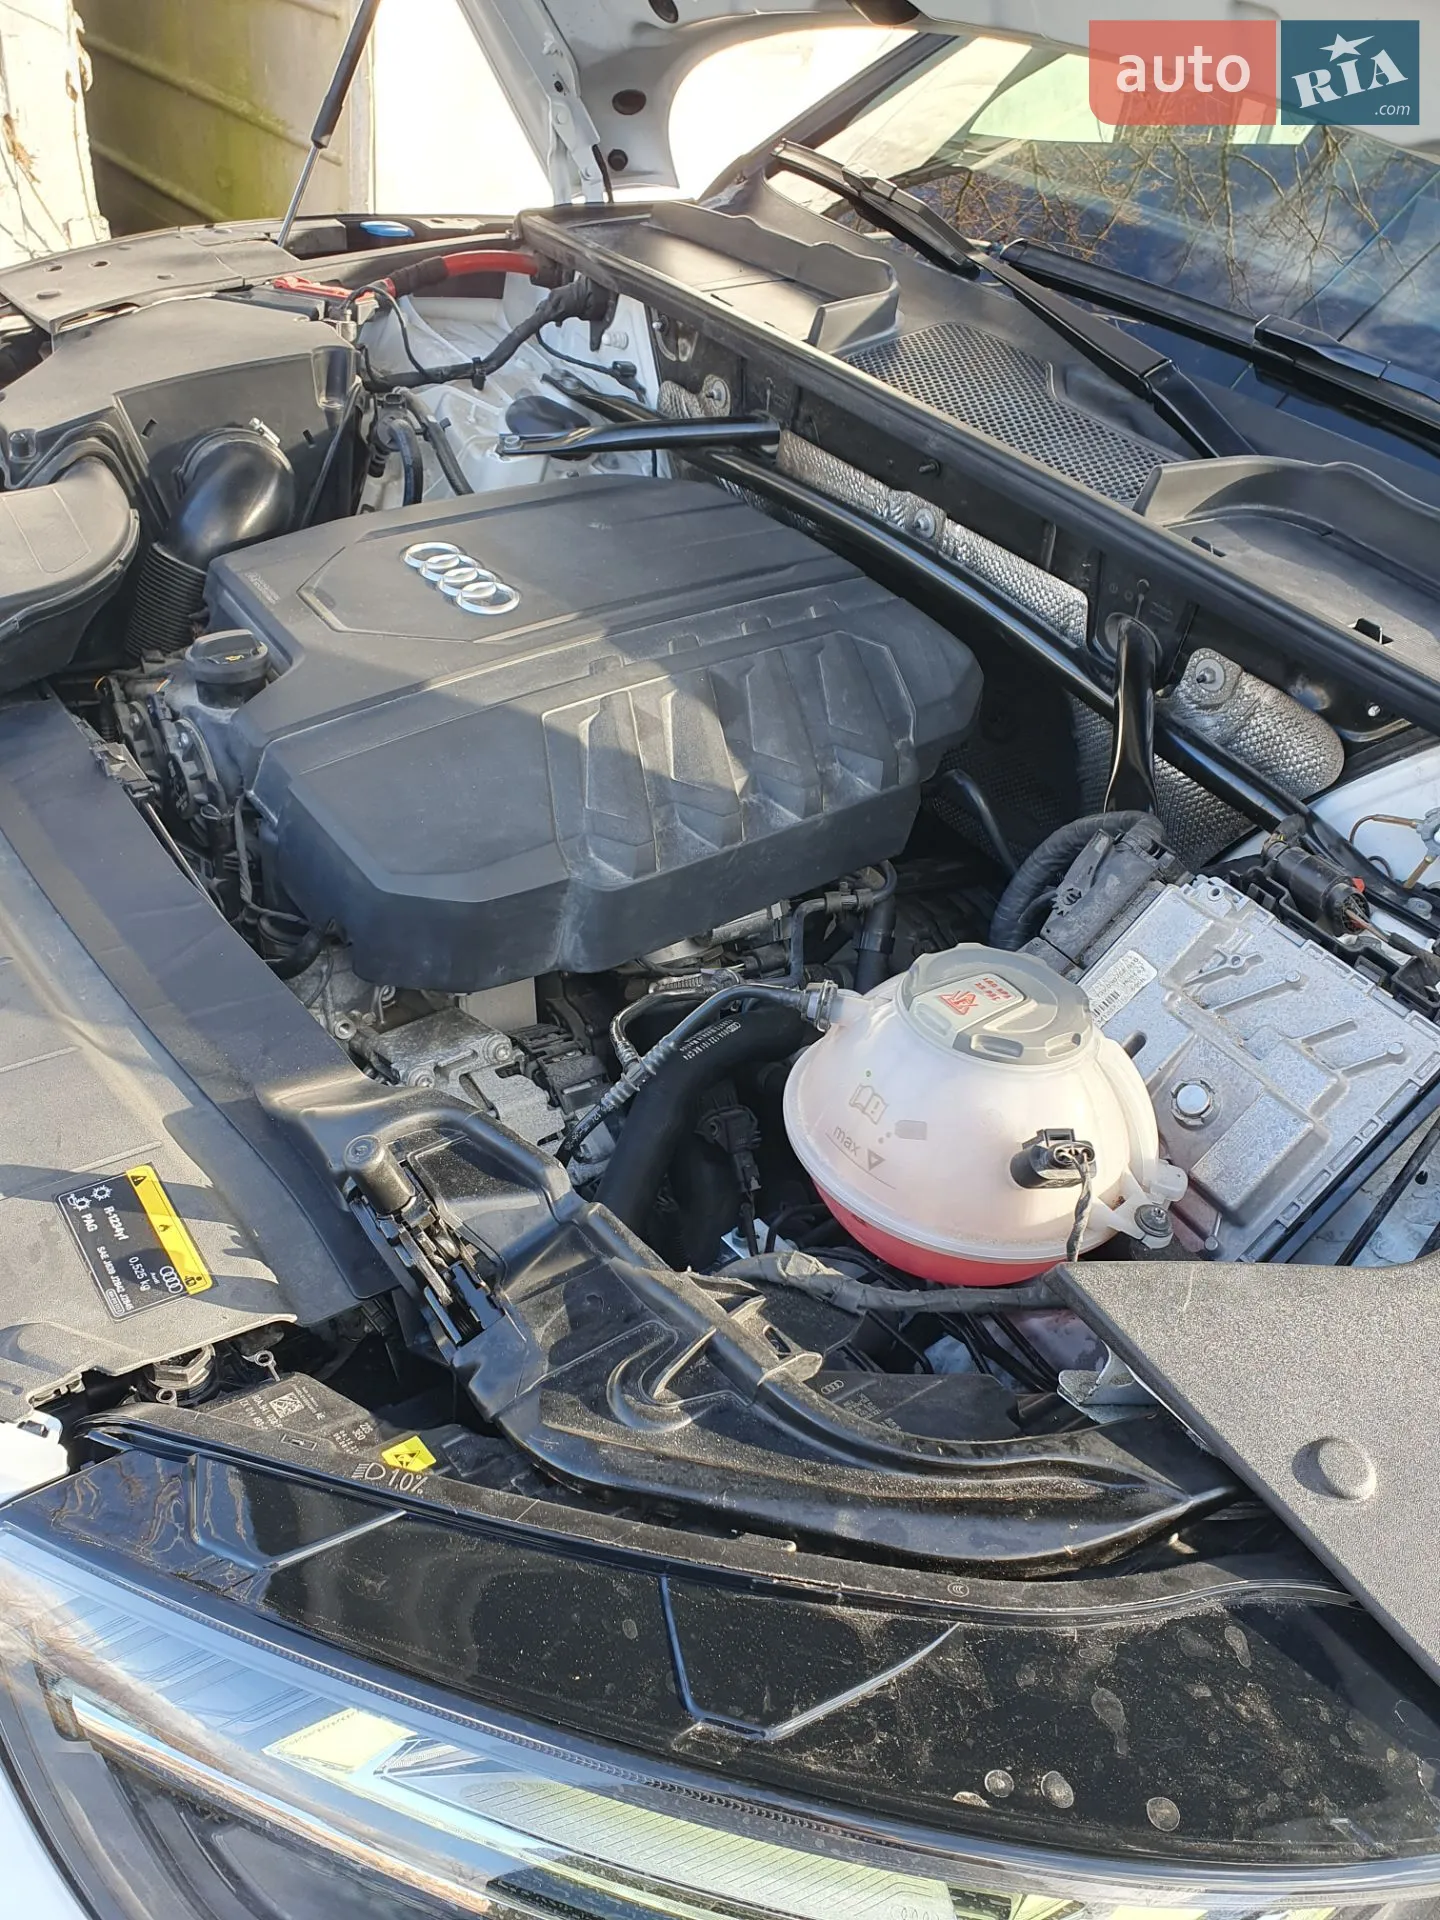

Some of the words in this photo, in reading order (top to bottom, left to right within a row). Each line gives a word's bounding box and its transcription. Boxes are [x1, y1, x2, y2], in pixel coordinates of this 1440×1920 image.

[833, 1125, 861, 1156] max
[81, 1213, 98, 1232] PAG
[103, 1206, 129, 1240] R-1234yf
[96, 1246, 109, 1260] SAE
[129, 1256, 147, 1280] 0,525
[139, 1279, 151, 1292] kg
[388, 1468, 428, 1494] 1,0%
